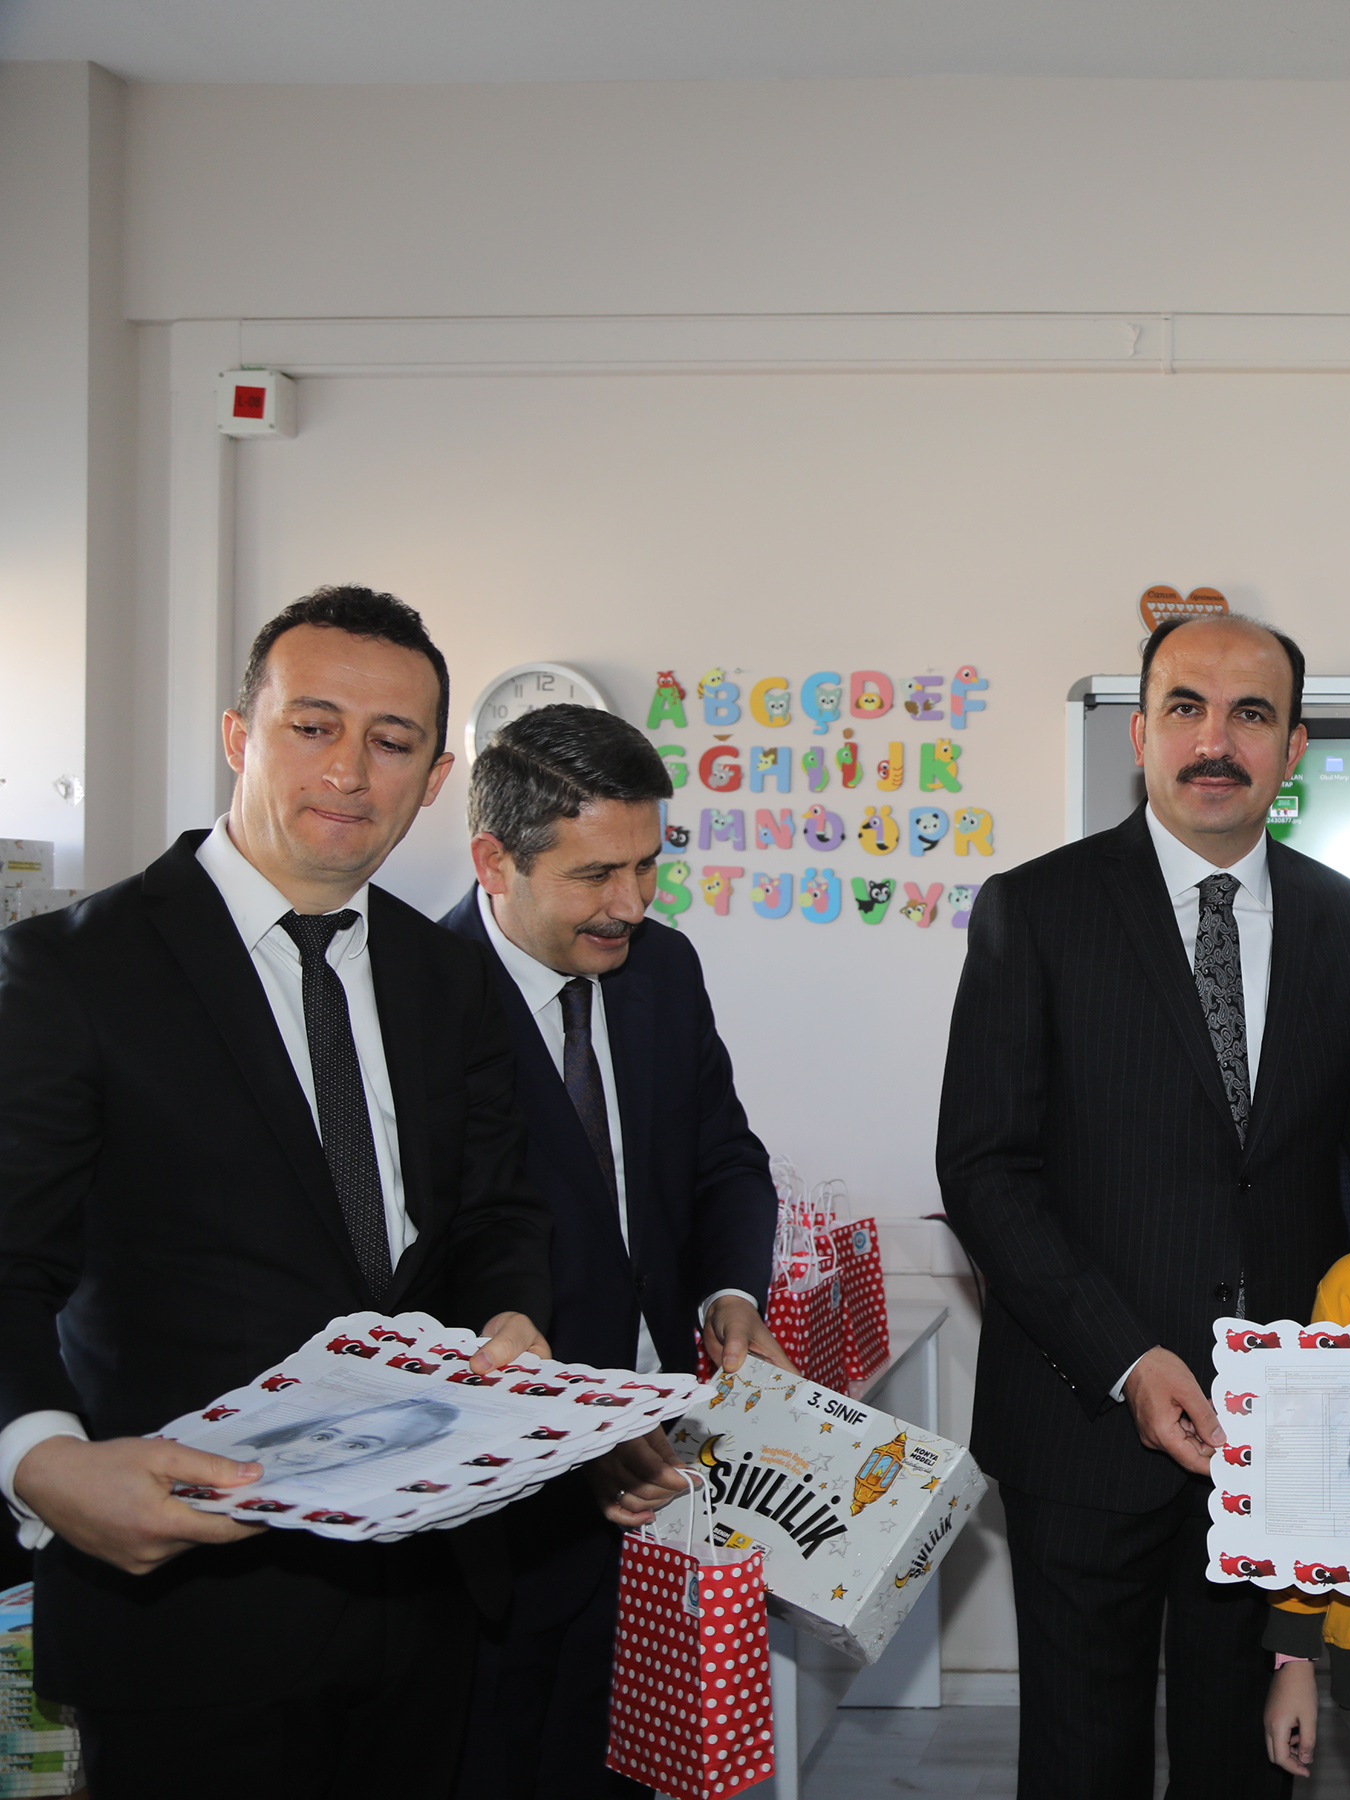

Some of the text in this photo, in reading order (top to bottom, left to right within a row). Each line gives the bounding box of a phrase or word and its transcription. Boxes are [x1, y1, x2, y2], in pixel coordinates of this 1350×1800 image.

[514, 684, 524, 699] 11
[536, 675, 555, 692] 12
[491, 704, 509, 720] 10
[807, 1391, 868, 1426] 3. SINIF
[914, 1447, 939, 1461] KONYA
